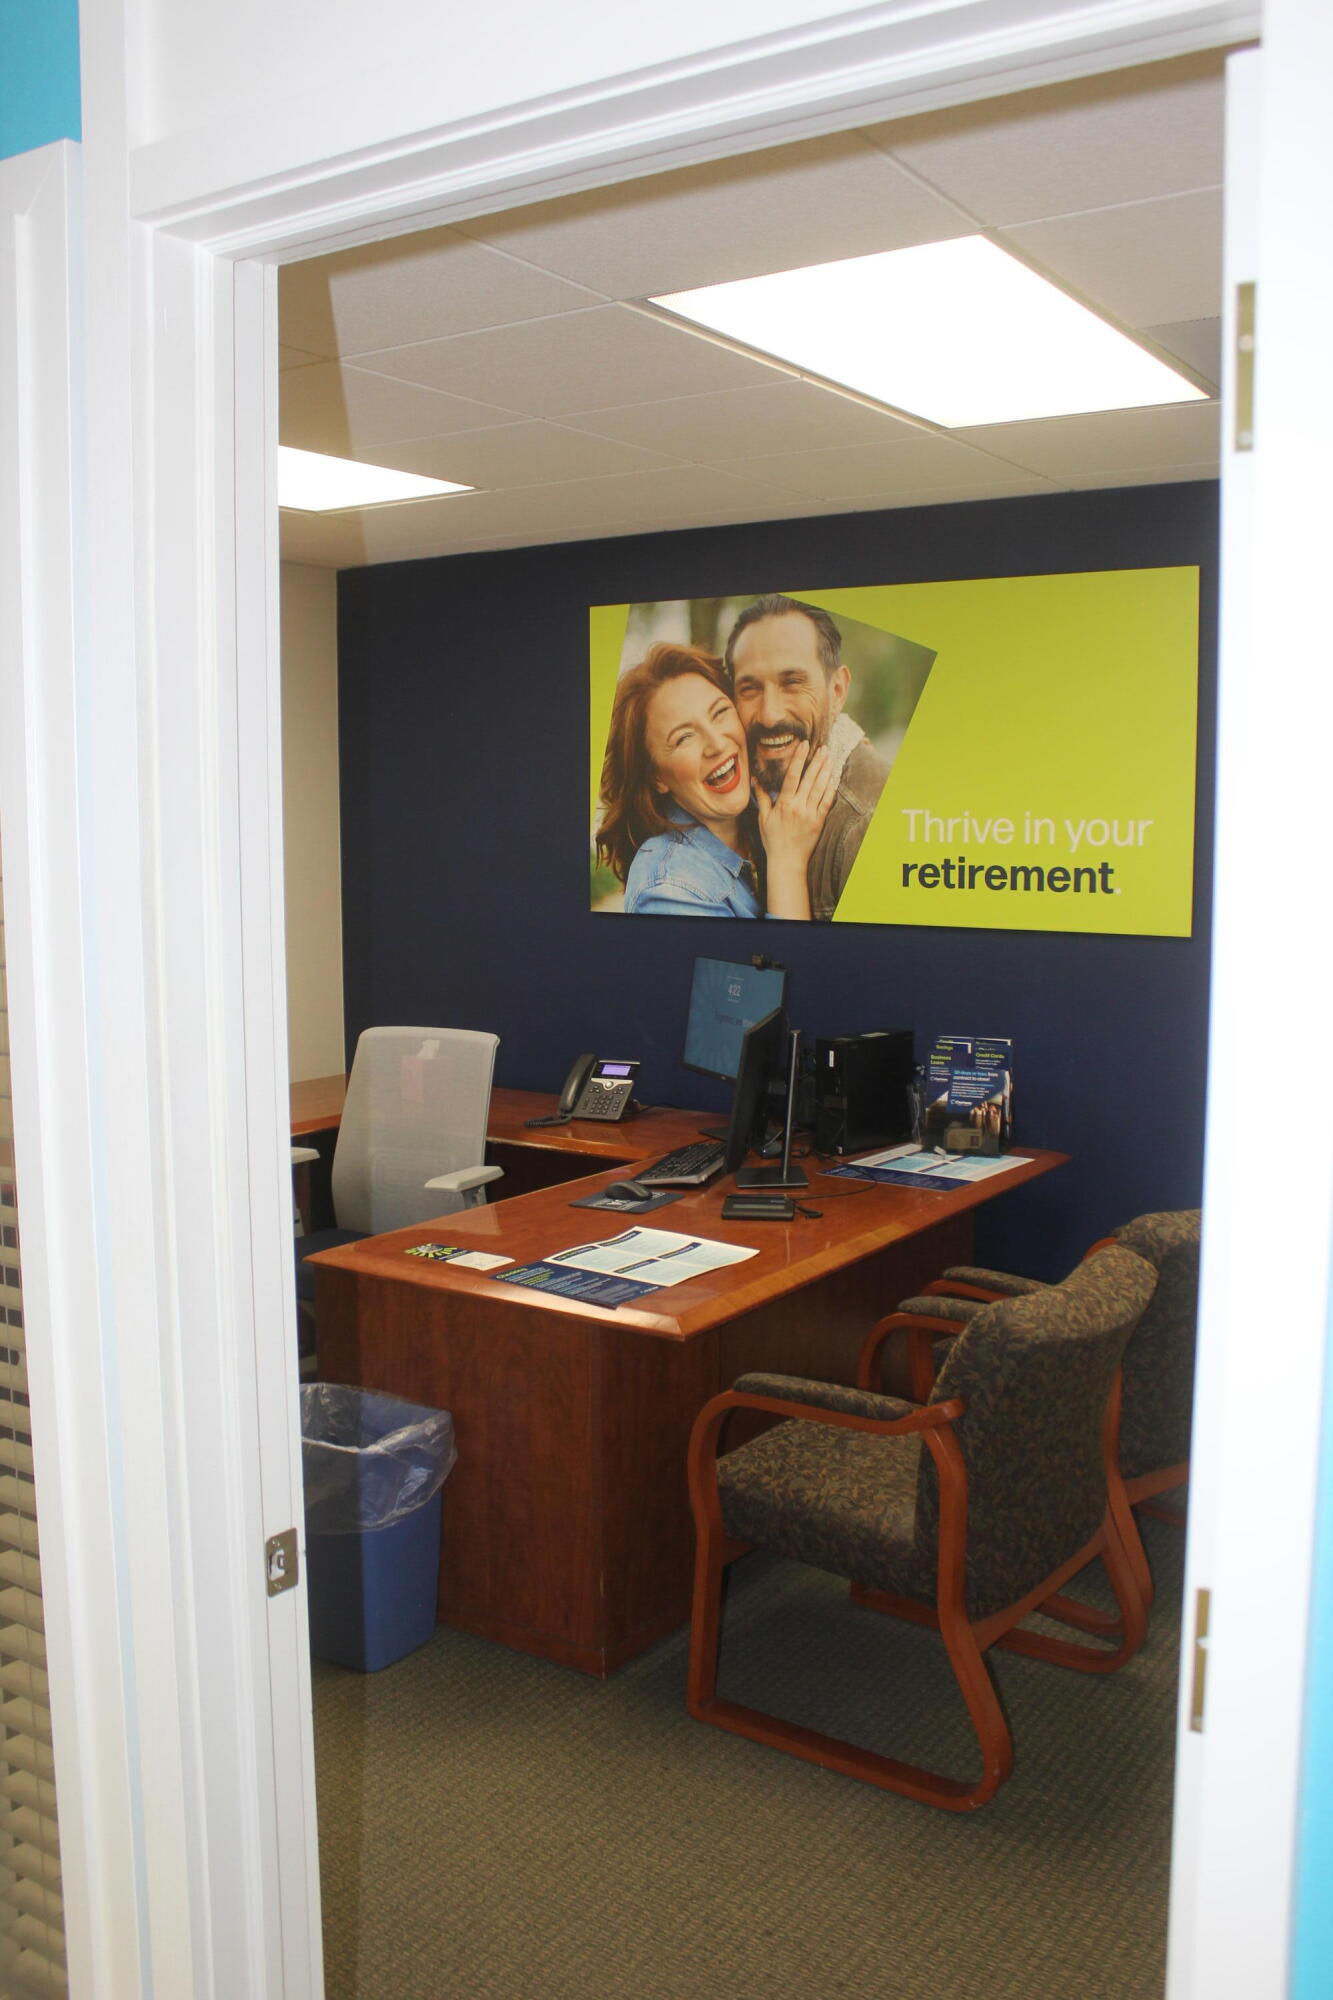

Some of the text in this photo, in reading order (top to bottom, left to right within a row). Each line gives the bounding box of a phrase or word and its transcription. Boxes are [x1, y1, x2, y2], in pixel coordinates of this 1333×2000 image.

[901, 809, 1153, 853] Thrive in your
